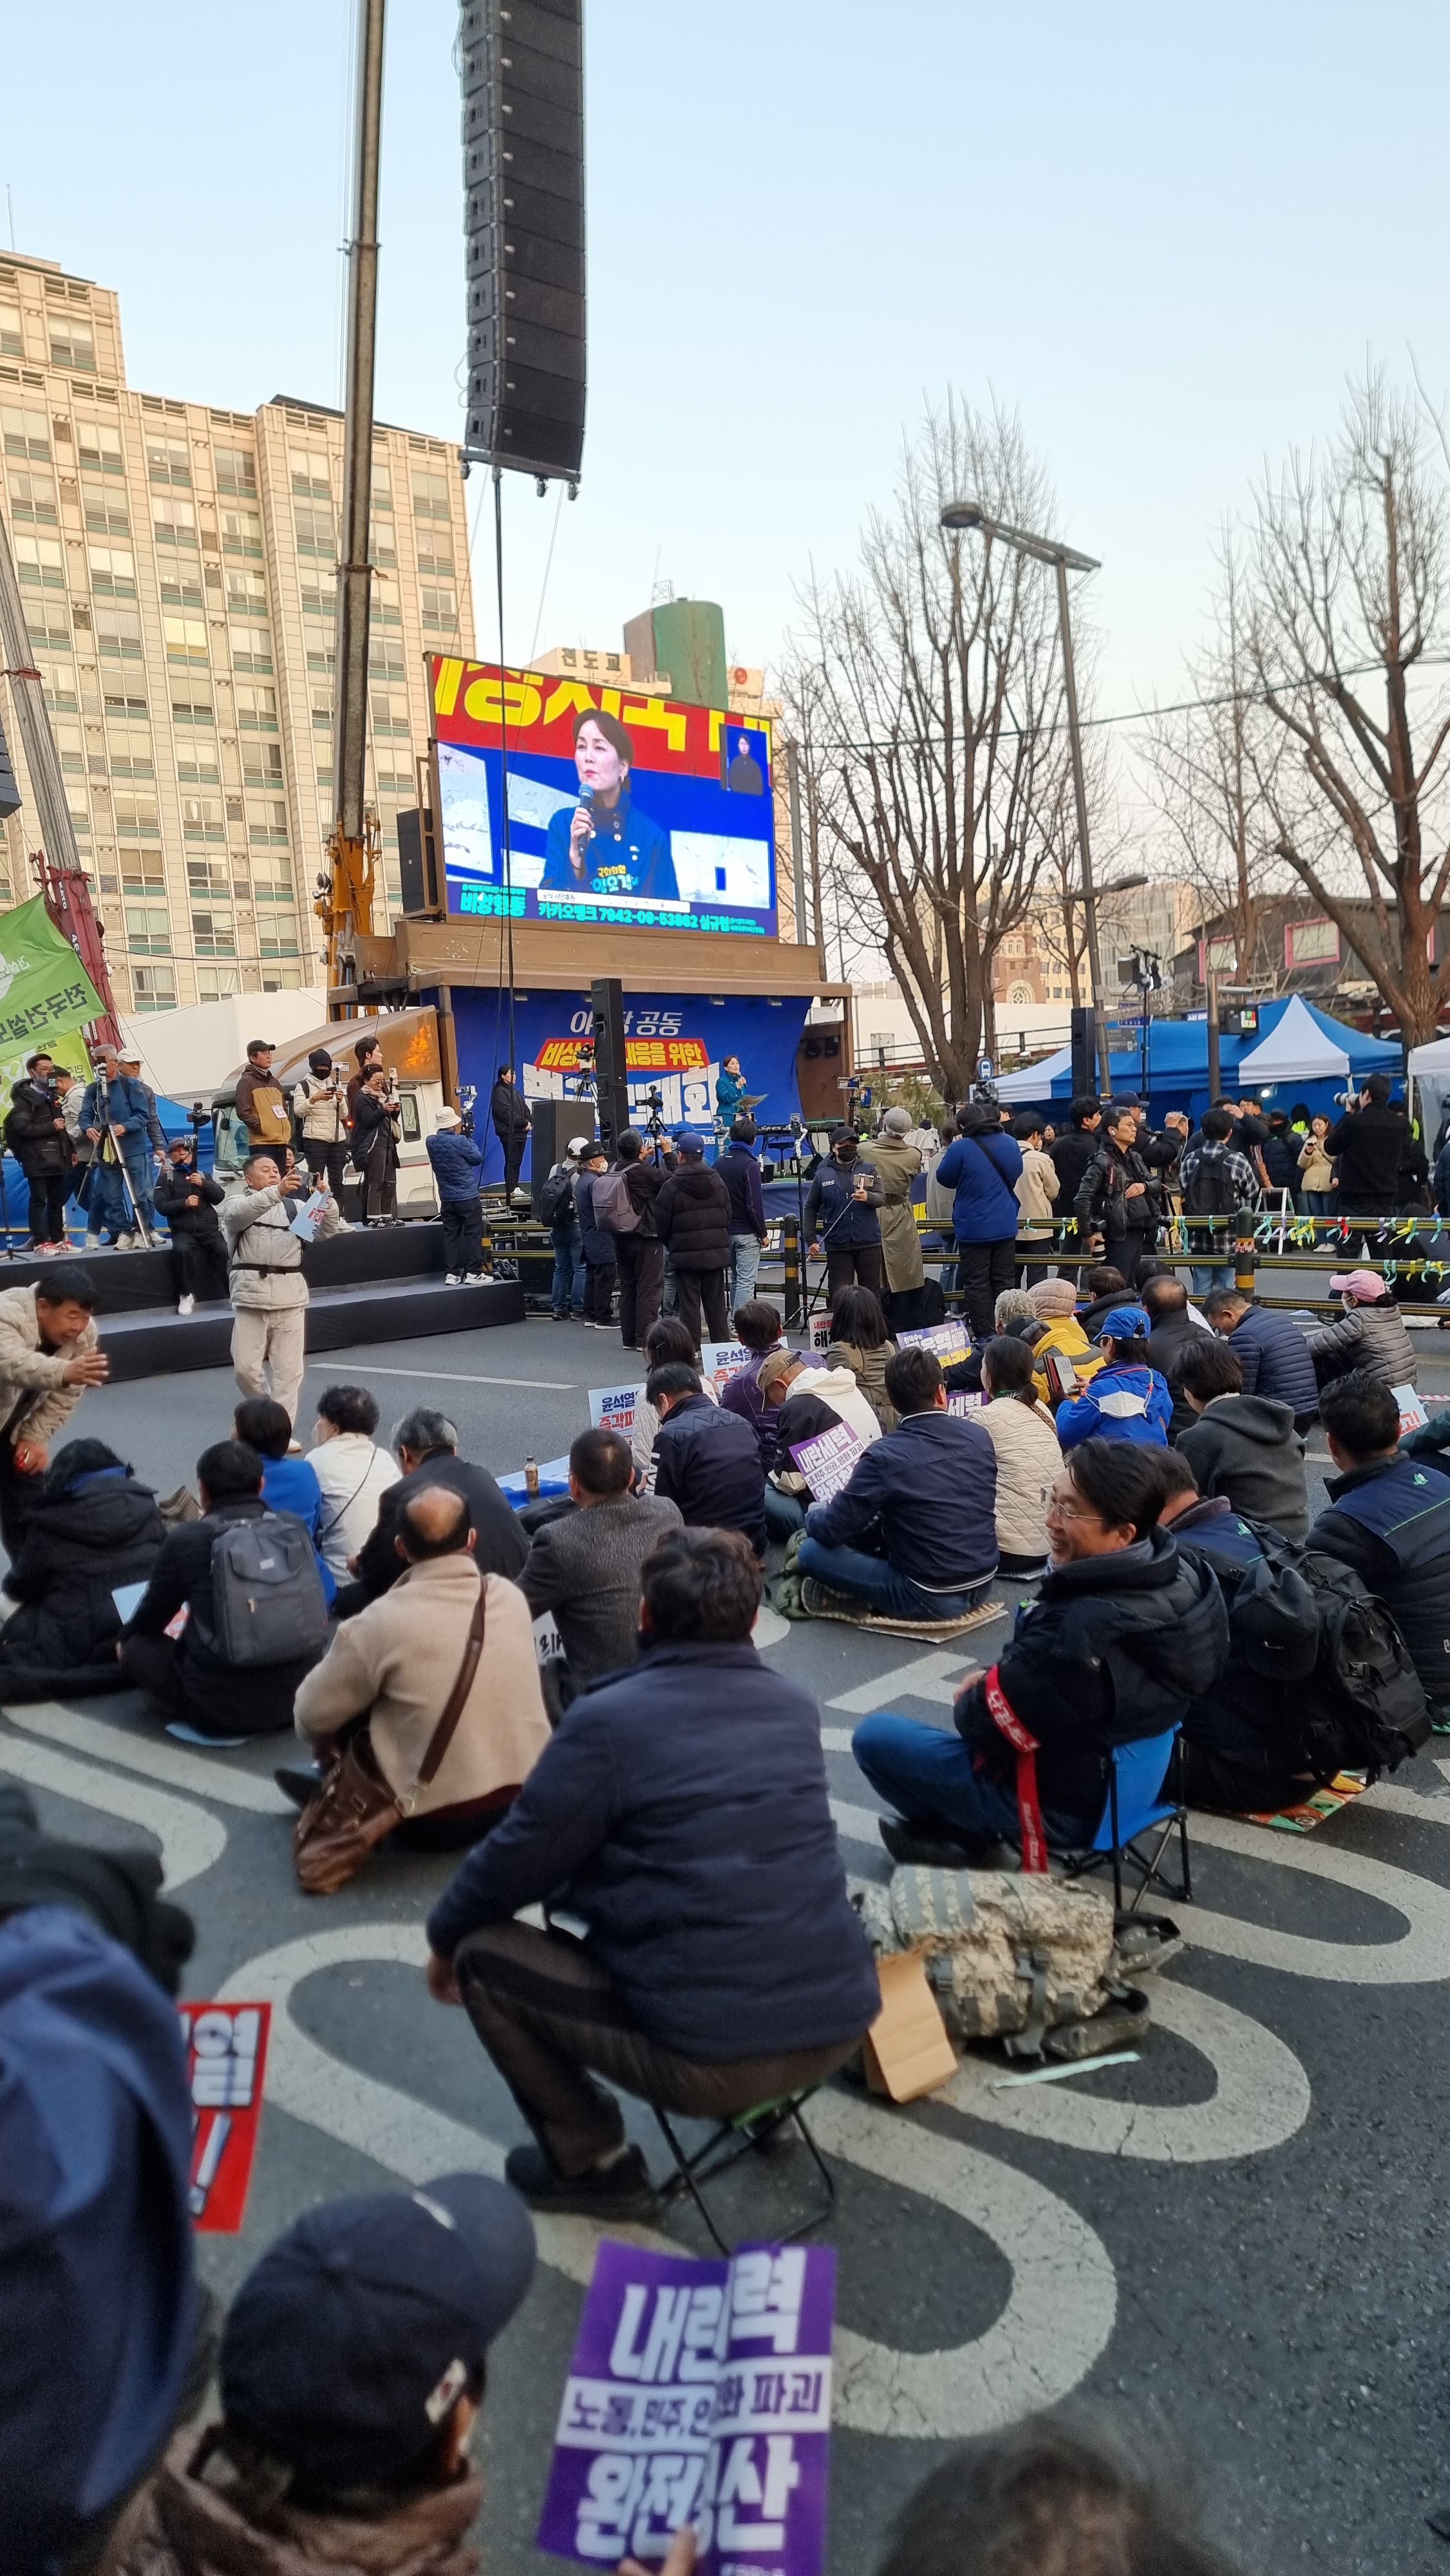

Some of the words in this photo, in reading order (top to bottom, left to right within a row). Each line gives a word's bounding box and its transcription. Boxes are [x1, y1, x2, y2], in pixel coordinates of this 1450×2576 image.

[538, 902, 598, 922] 카카오뱅크
[636, 1011, 683, 1036] 공동
[668, 1043, 704, 1067] 위한
[602, 1390, 639, 1412] 윤석열
[797, 1424, 852, 1473] 내란세력
[751, 2370, 822, 2416] 파괴
